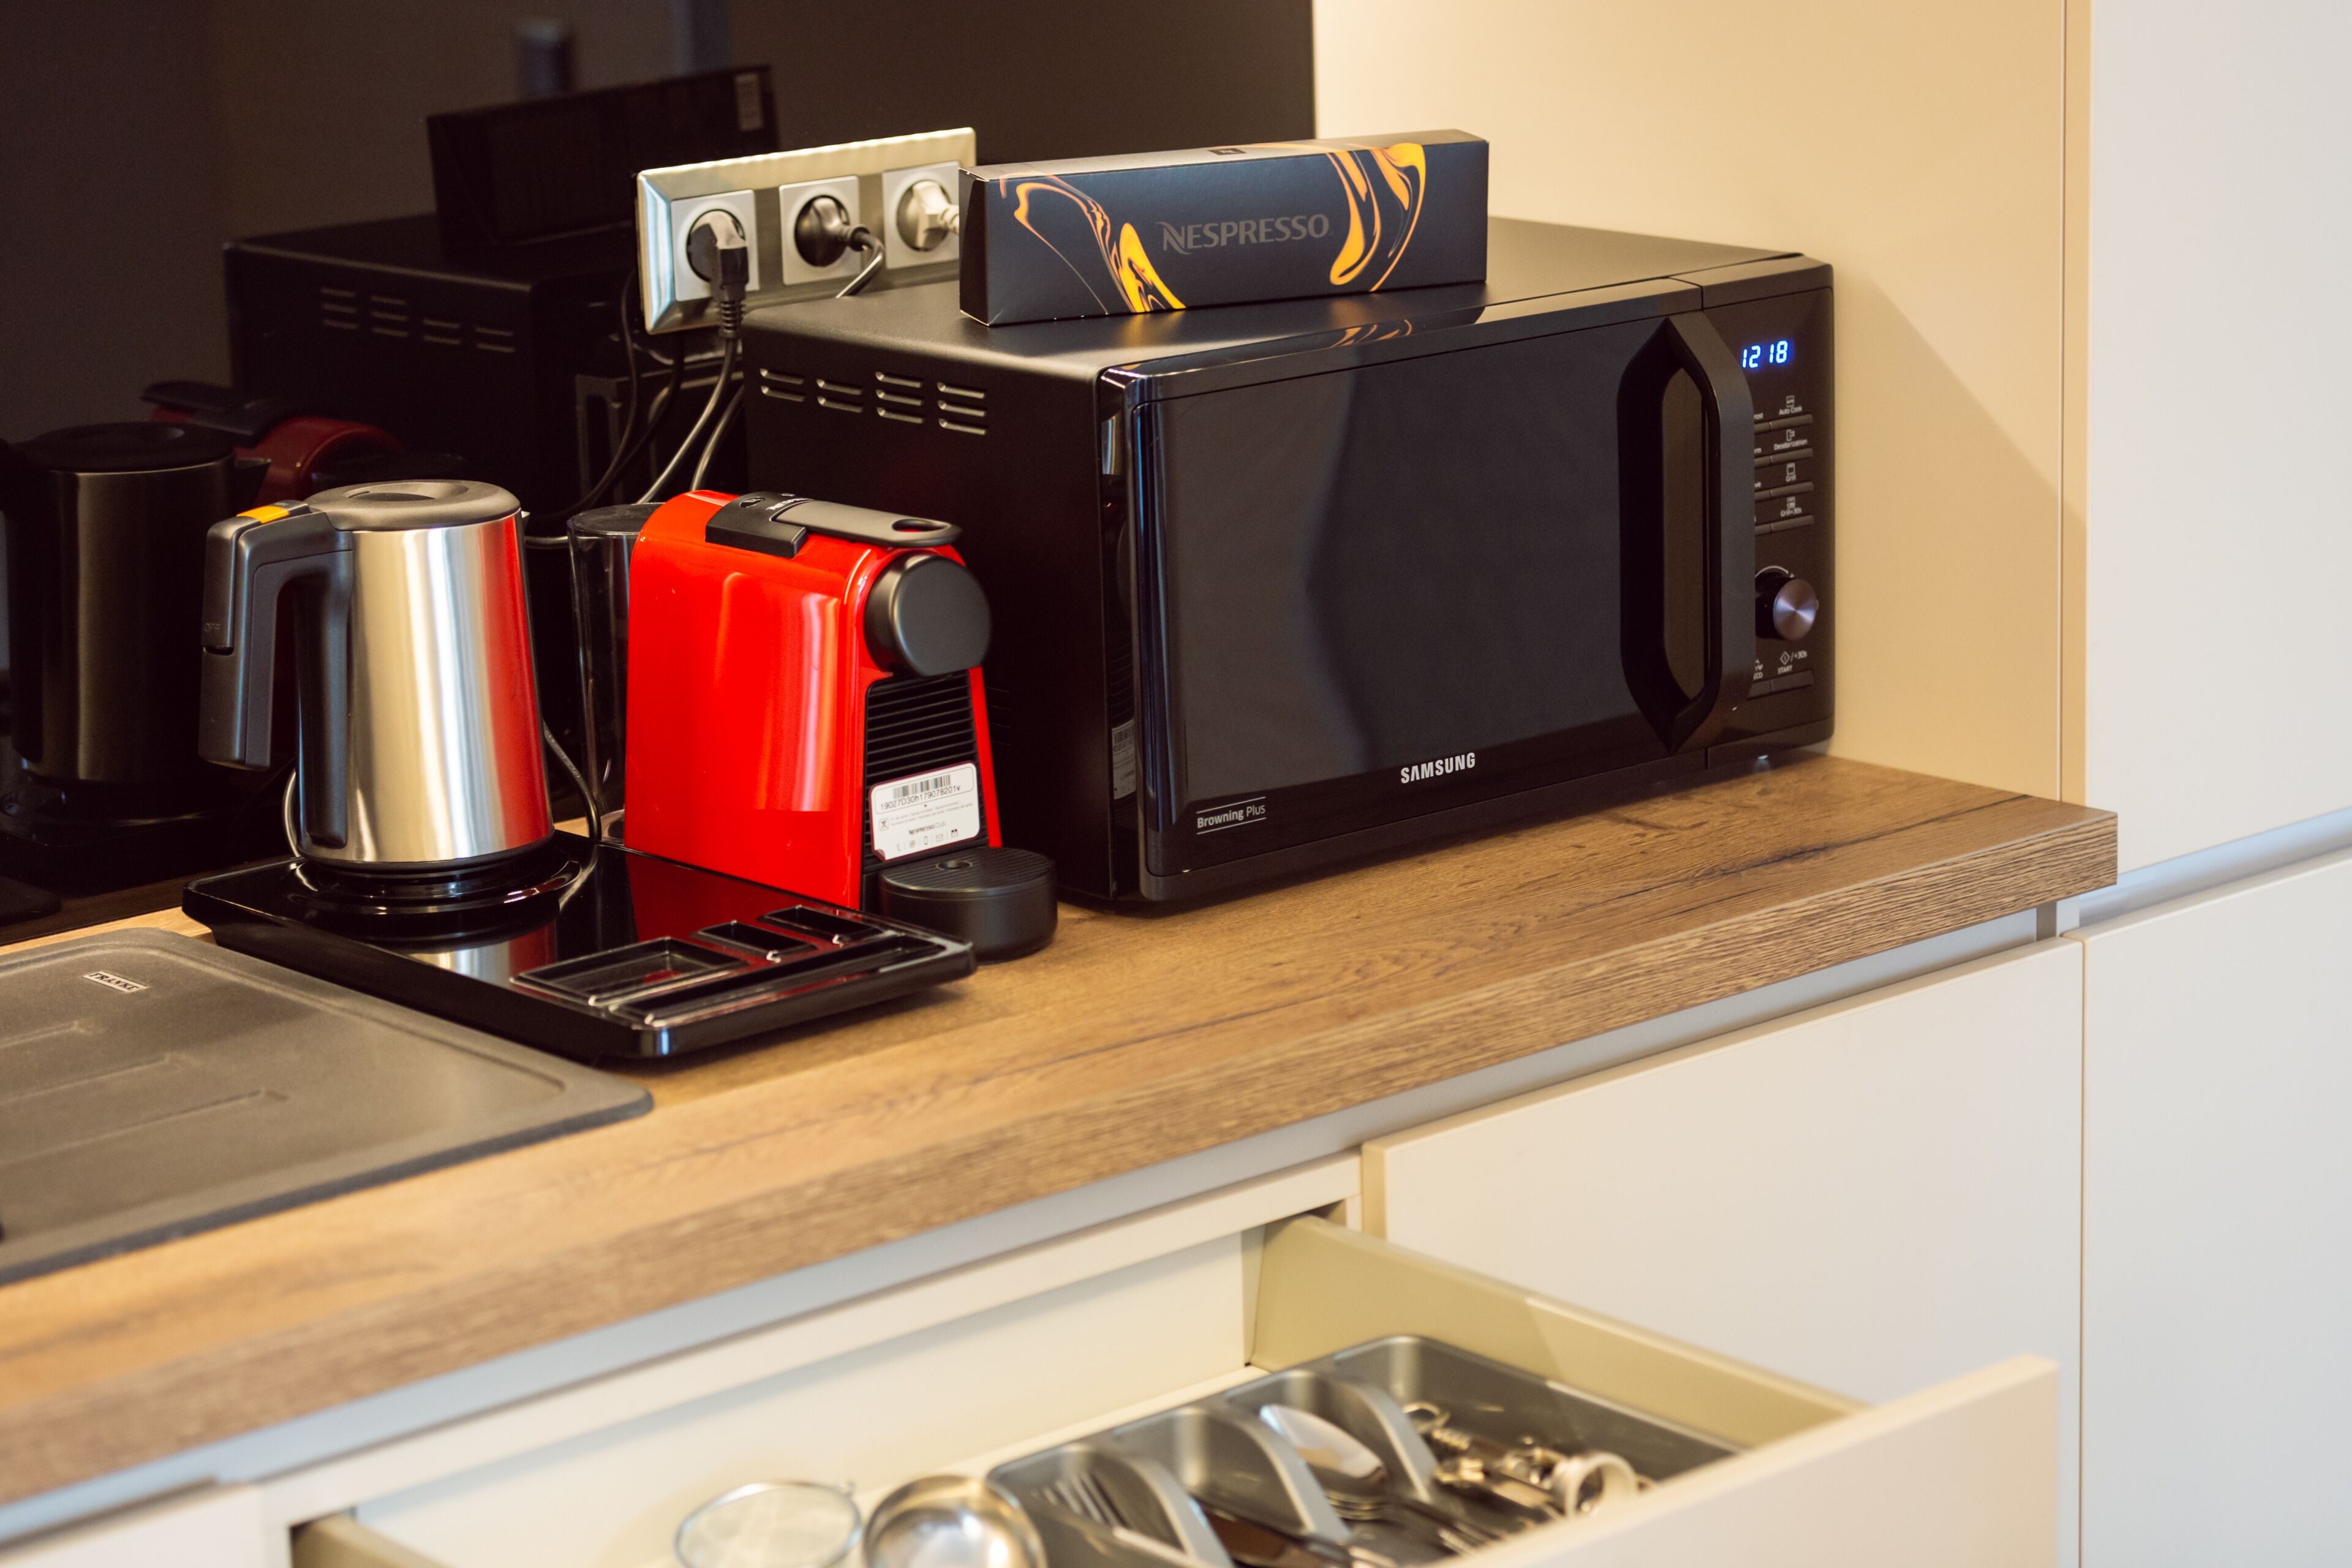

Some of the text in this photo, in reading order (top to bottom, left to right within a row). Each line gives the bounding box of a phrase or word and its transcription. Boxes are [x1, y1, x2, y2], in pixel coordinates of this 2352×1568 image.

[1155, 213, 1330, 255] NESPRESSO
[1774, 439, 1808, 451] Deodorization
[1777, 665, 1793, 674] START
[1400, 752, 1476, 784] SAMSUNG
[1197, 804, 1266, 829] Browning Plus
[88, 973, 140, 991] FRANKE
